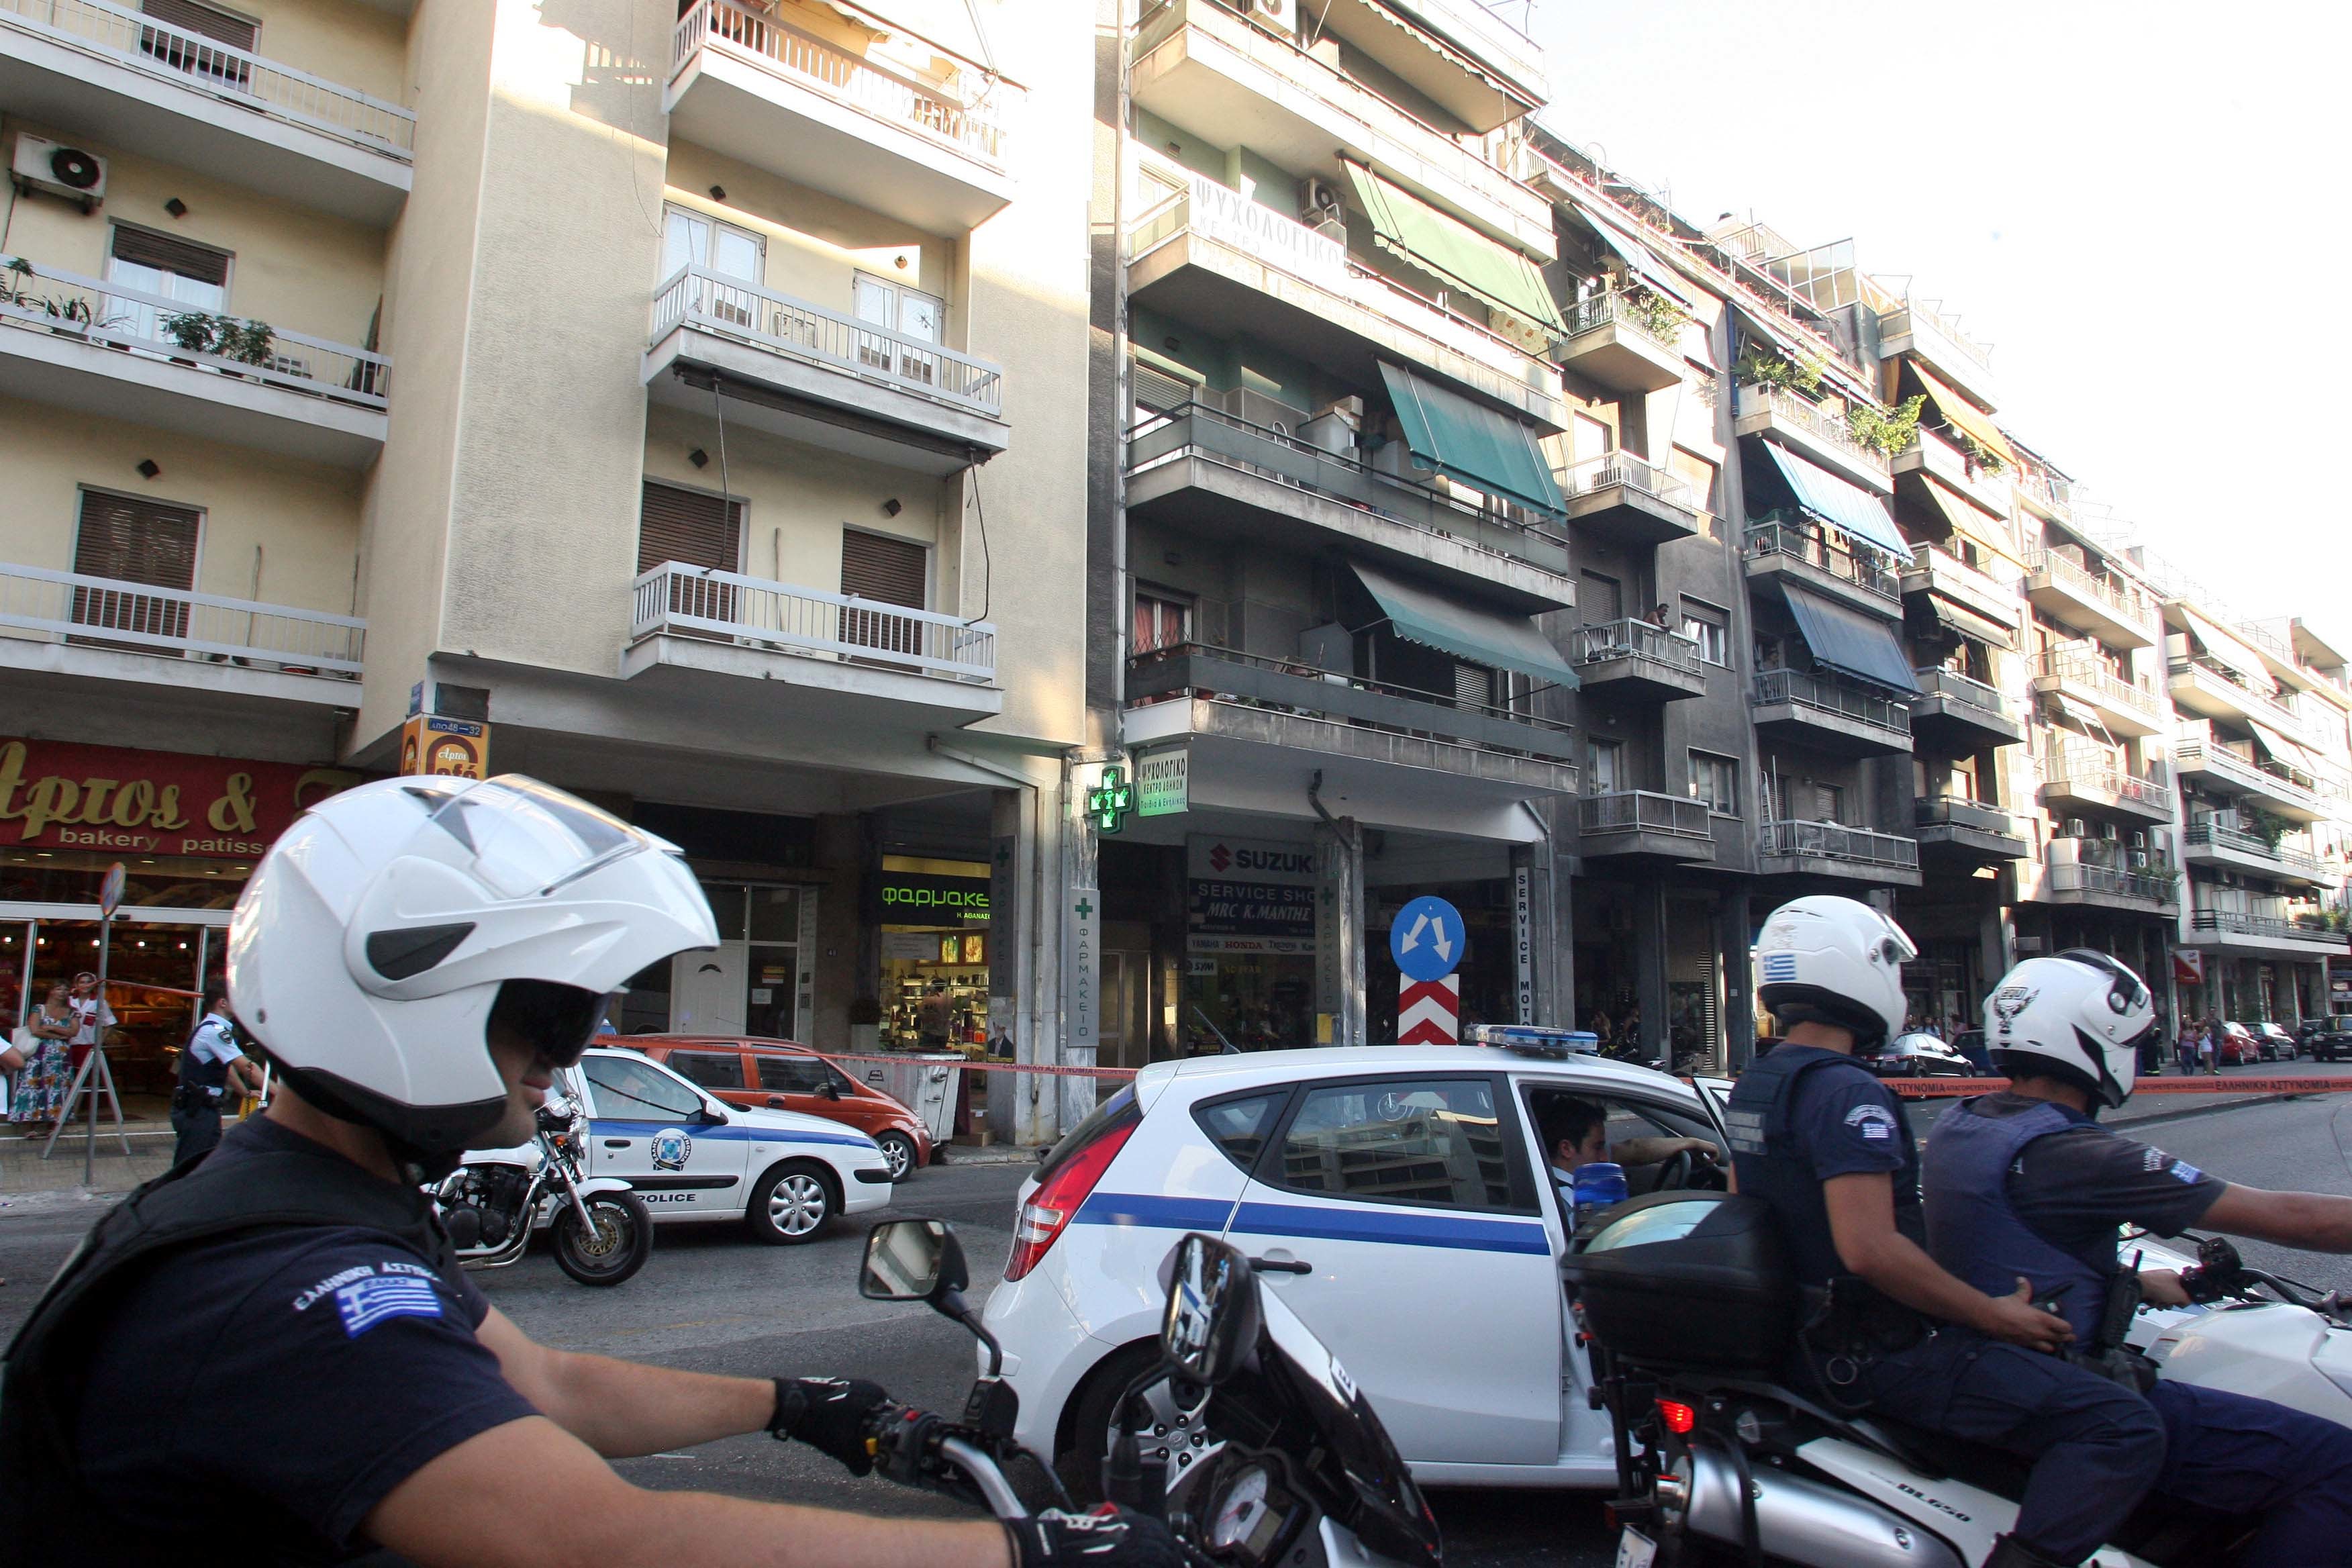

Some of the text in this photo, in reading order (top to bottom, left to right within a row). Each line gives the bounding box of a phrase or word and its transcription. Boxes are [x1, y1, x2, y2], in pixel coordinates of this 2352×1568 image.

[1142, 758, 1185, 781] ΨΥΧΟΛΟΓΙΚΟ
[207, 773, 258, 834] &
[60, 829, 160, 852] bakery
[1198, 883, 1277, 901] SERVICE
[1518, 875, 1528, 963] SERVICE
[1224, 941, 1263, 950] HONDA
[1079, 928, 1089, 1036] ΦΑΡΜΑΚΕΙΟ
[2216, 1081, 2267, 1089] ΕΛΛΗΝΙΚΗ
[2270, 1080, 2331, 1089] ΑΣΤΥΝΟΜΙΑ
[638, 1193, 696, 1203] POLICE
